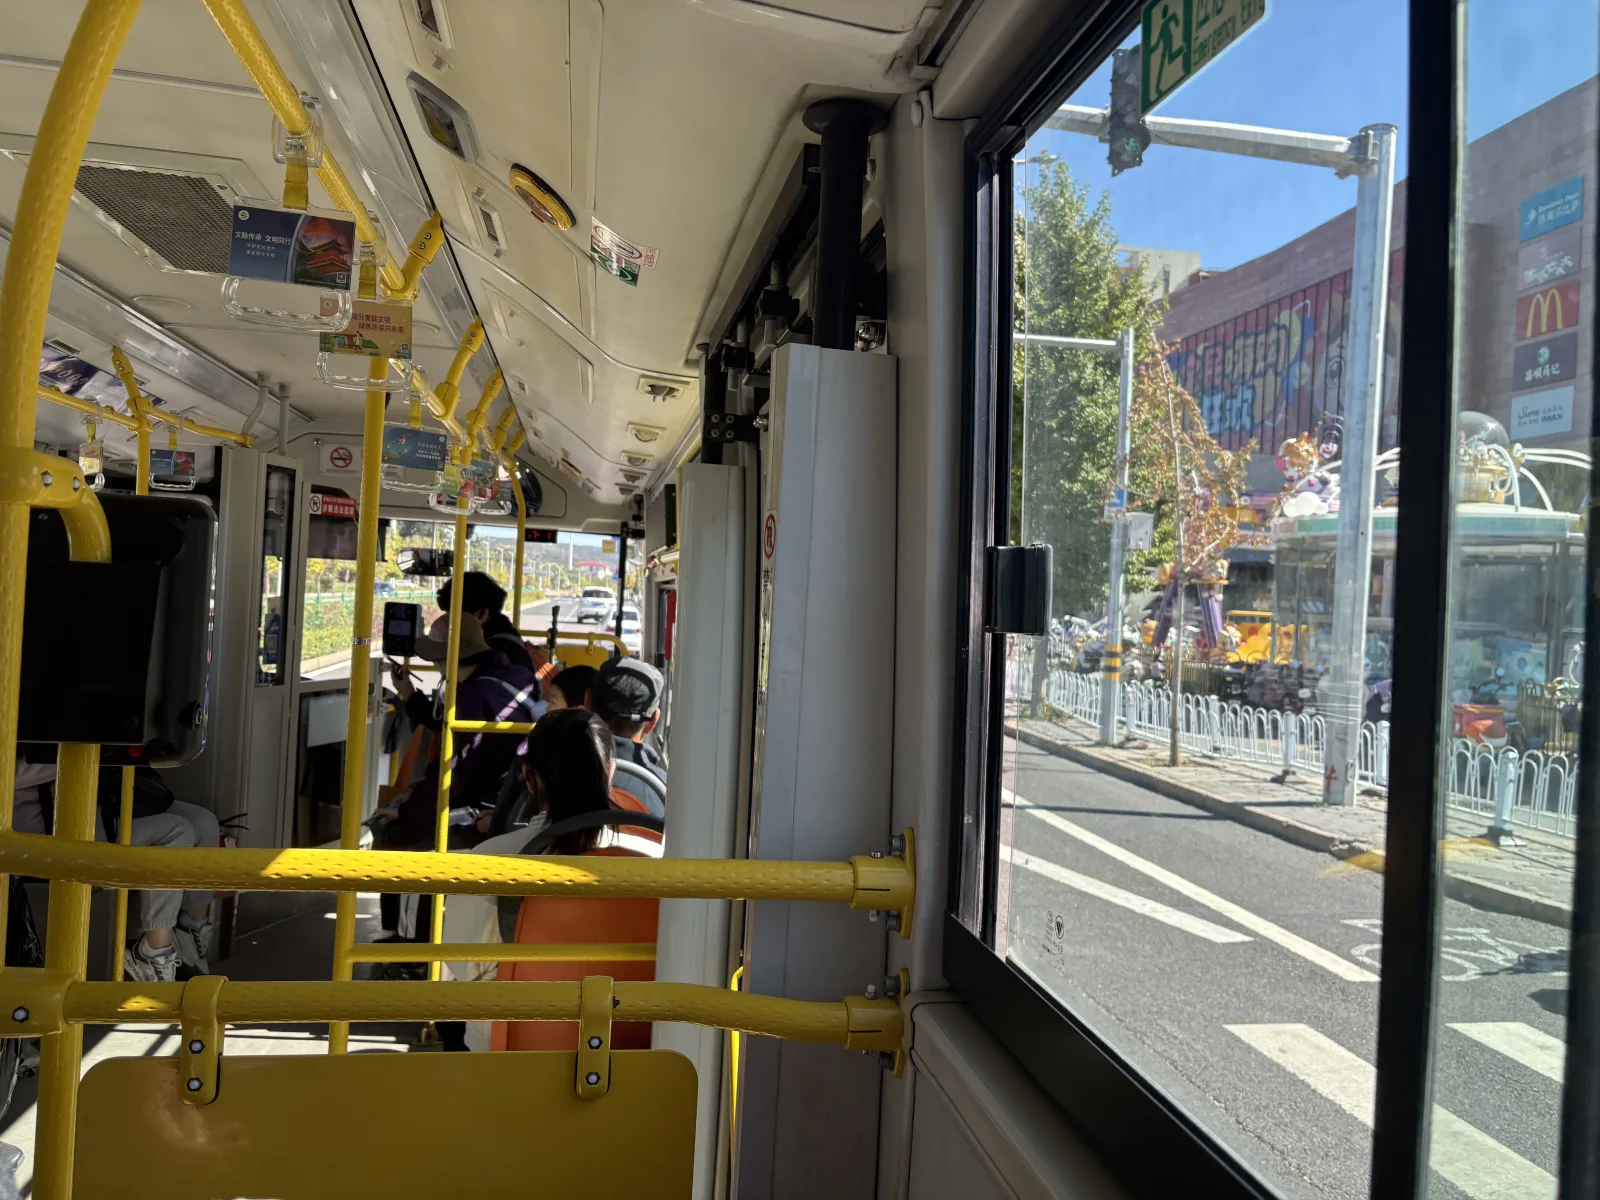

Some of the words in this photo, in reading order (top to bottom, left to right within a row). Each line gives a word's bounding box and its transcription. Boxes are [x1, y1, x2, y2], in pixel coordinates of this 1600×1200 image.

[1193, 14, 1236, 66] Emergency
[235, 231, 262, 241] 文脉传承
[264, 235, 291, 246] 文明同行
[358, 322, 405, 334] 绿色环保向未来
